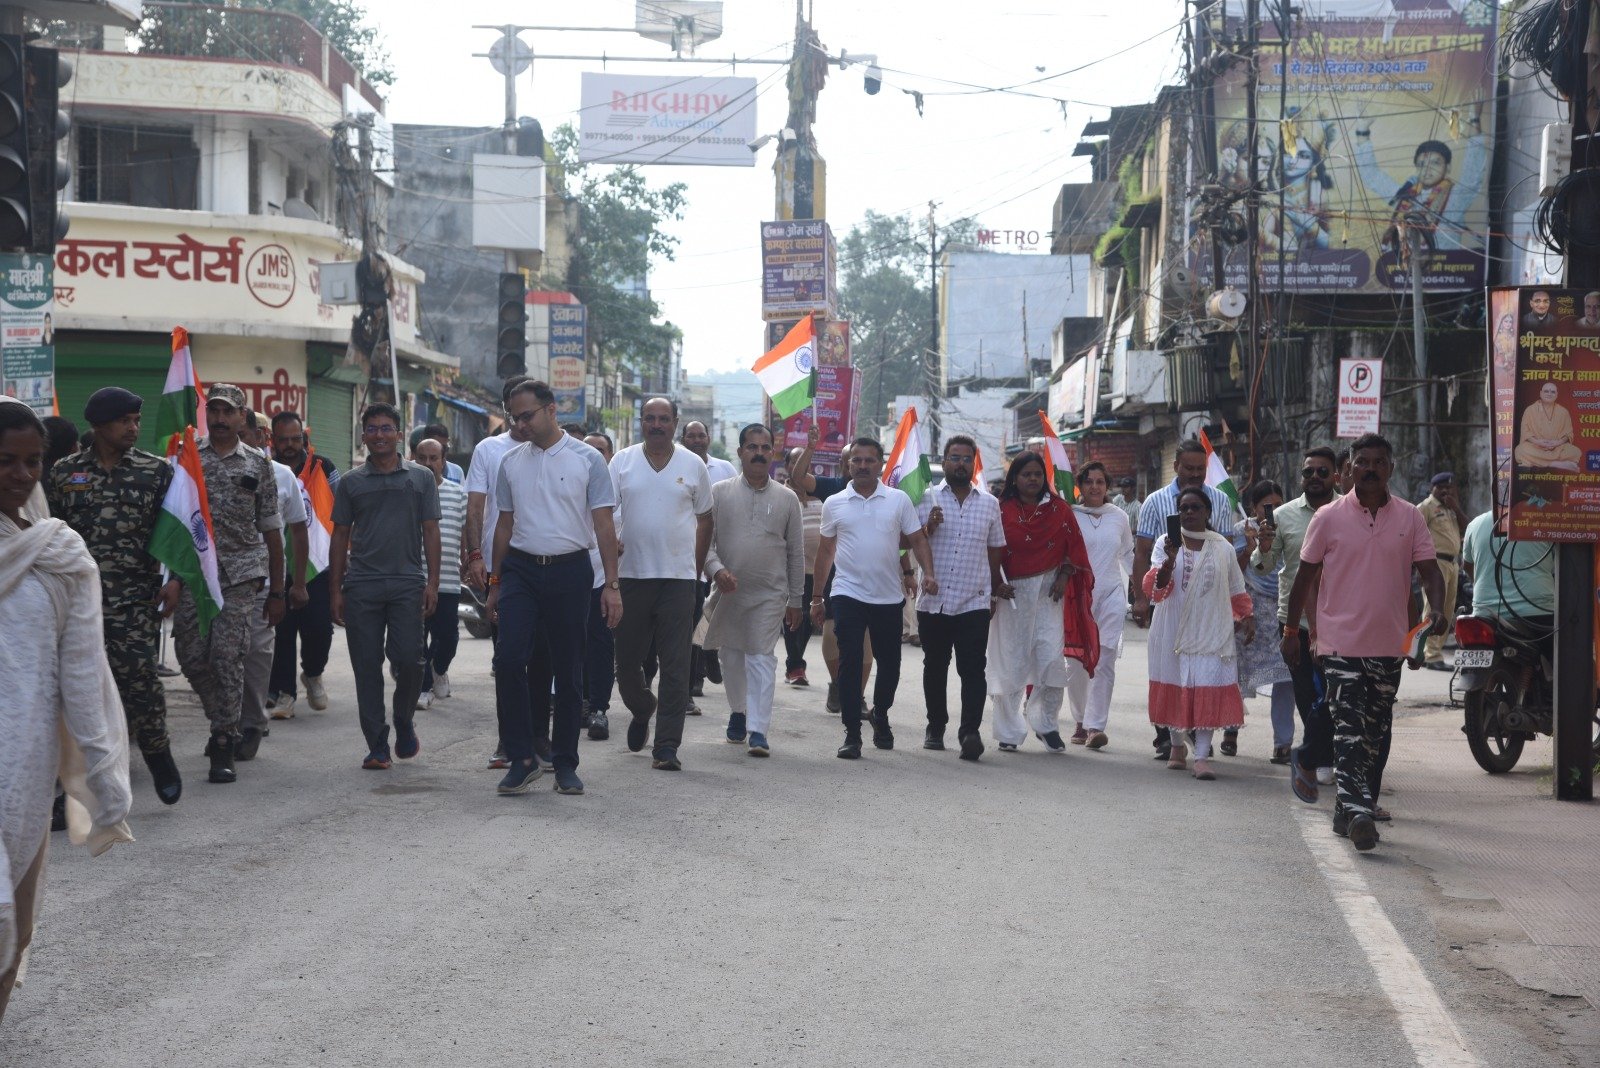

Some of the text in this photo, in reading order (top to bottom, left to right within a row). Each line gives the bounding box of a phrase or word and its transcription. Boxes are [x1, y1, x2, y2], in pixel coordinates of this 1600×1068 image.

[1368, 62, 1400, 74] 2024
[1404, 61, 1429, 73] तक
[978, 229, 1040, 245] METRO
[132, 233, 246, 284] स्टोर्स
[257, 253, 289, 278] JMS
[1535, 352, 1564, 369] कथा
[1341, 396, 1378, 405] NO PARKING
